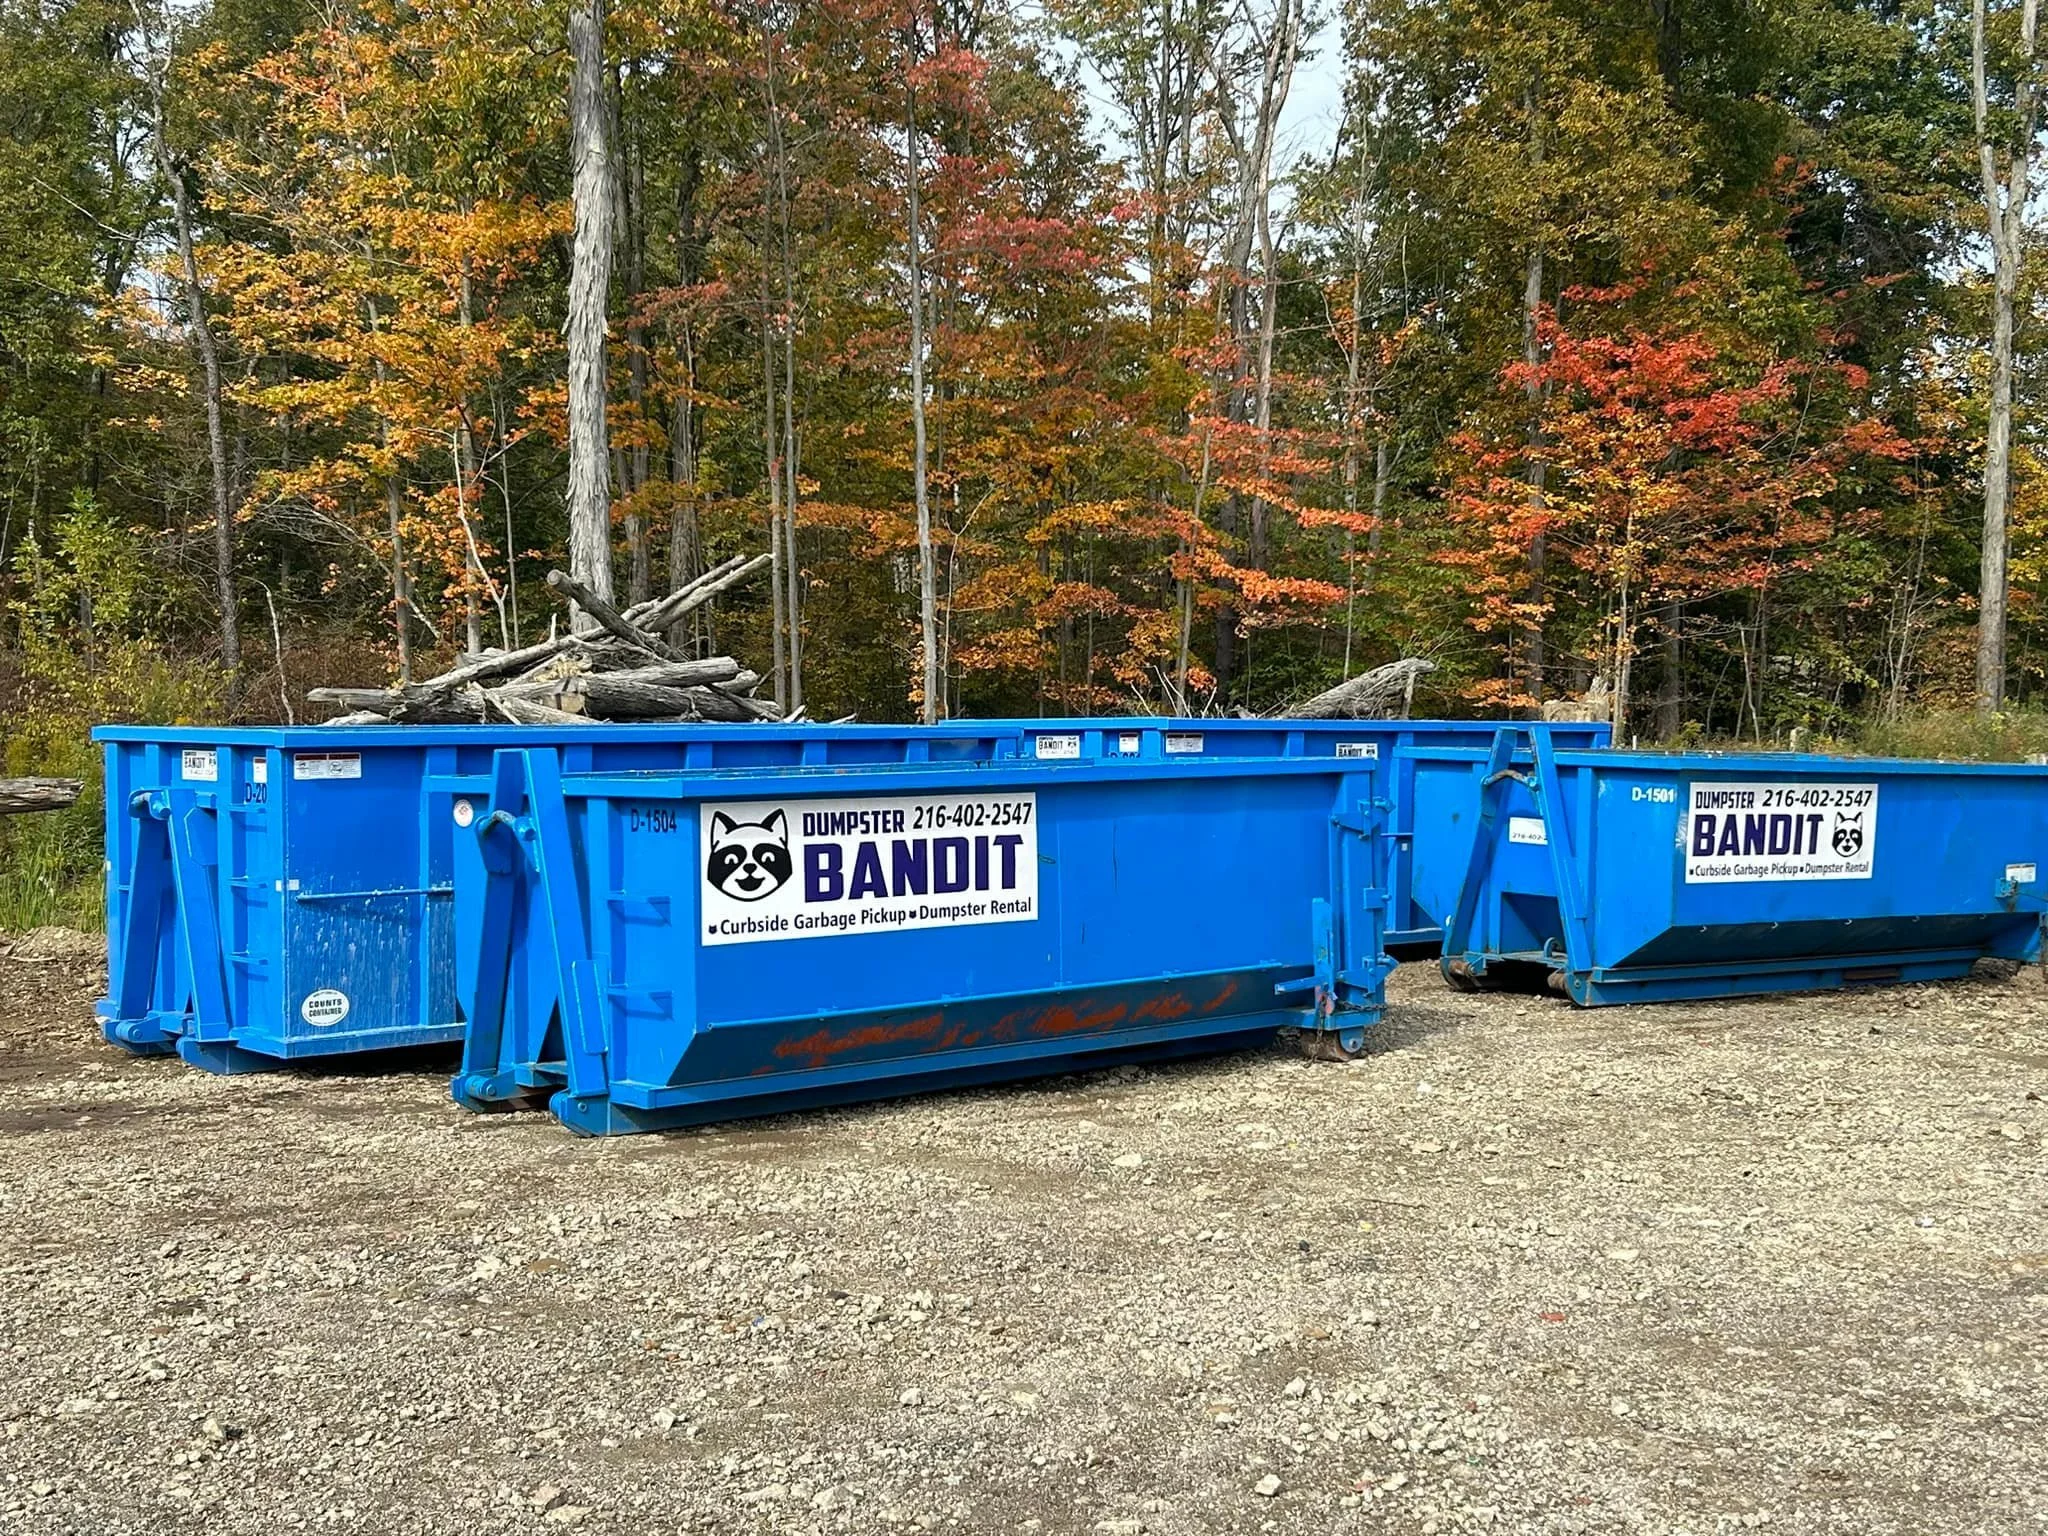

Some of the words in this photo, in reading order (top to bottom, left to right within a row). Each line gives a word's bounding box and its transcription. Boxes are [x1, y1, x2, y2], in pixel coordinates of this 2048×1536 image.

[1039, 740, 1063, 750] BANDIT
[1631, 786, 1675, 803] D-1501
[1695, 791, 1755, 809] DUMPSTER
[1762, 789, 1873, 807] 216-402-2547
[631, 808, 678, 833] D-1504
[803, 809, 905, 837] DUMPSTER
[913, 802, 1033, 830] 216-402-2547
[1692, 813, 1824, 857] BANDIT
[803, 834, 1024, 904] BANDIT
[1695, 864, 1731, 877] Curbside
[1734, 864, 1769, 878] Garbage
[1771, 862, 1799, 877] Pickup
[1805, 862, 1844, 876] Dumpster
[1845, 861, 1869, 873] Rental
[720, 914, 789, 935] Curbside
[794, 911, 856, 930] Garbage
[861, 907, 906, 925] Pickup
[919, 902, 987, 921] Dumpster
[991, 896, 1032, 914] Rental
[309, 999, 342, 1008] COUNTS
